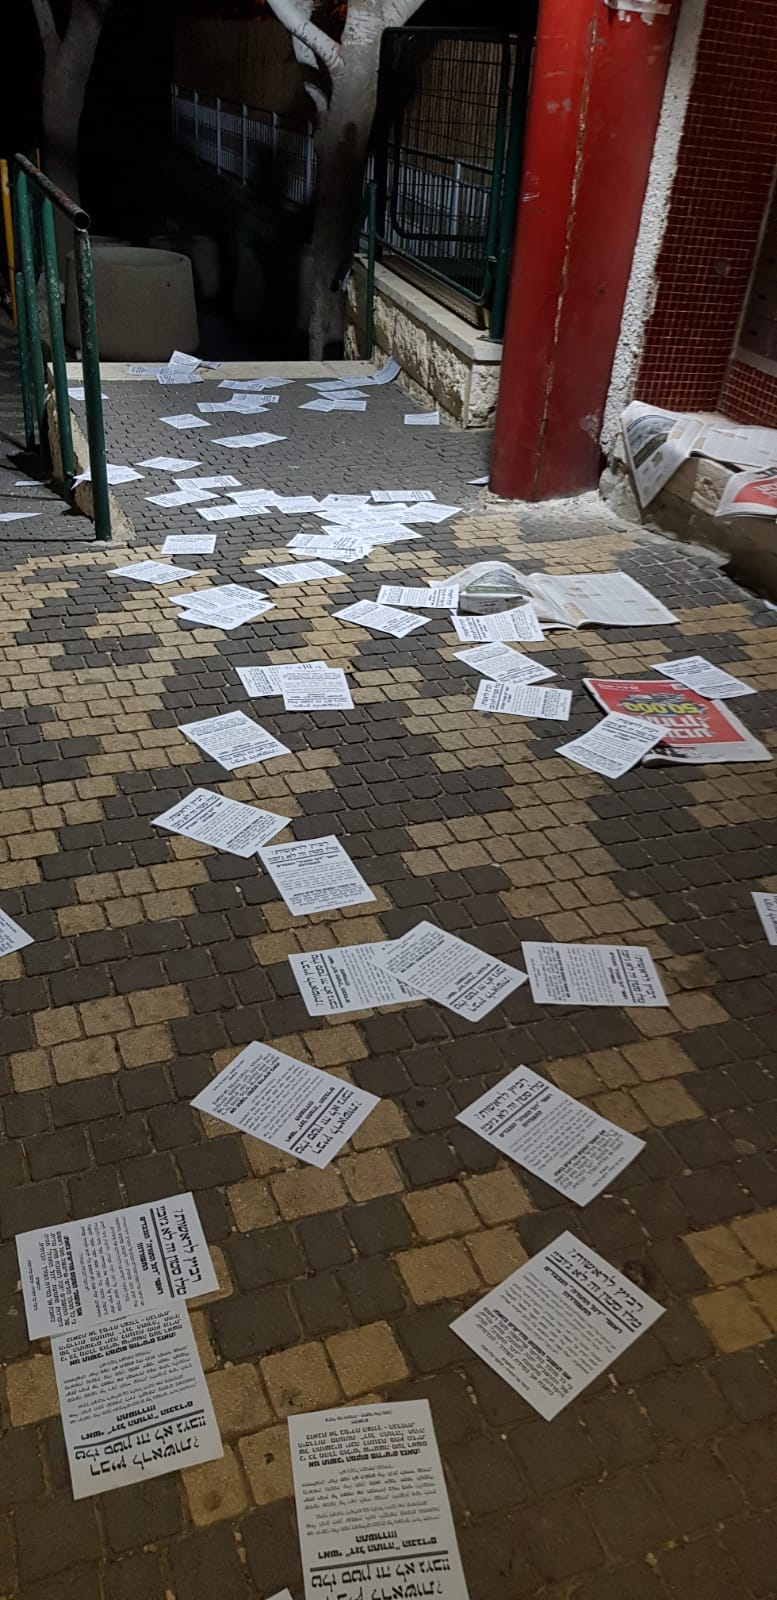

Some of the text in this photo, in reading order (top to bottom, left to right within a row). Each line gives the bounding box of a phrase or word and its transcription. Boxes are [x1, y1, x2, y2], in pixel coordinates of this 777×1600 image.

[527, 1080, 544, 1092] טלז
[473, 1078, 528, 1118] רביץ לראשות?
[506, 1102, 517, 1110] זה
[514, 1090, 532, 1105] סטון
[285, 1130, 297, 1142] ראשי
[318, 1086, 335, 1103] הנכבדים
[495, 1108, 508, 1119] לא
[294, 1140, 312, 1154] טלז
[306, 1123, 323, 1140] סטון
[321, 1116, 331, 1124] זה
[328, 1104, 341, 1116] לא
[312, 1102, 362, 1153] רביץ לראשות?
[139, 1216, 150, 1238] הנכבדים
[161, 1227, 176, 1240] לא
[165, 1242, 175, 1252] זה
[174, 1208, 201, 1282] רביץ לראשות?
[165, 1254, 181, 1275] סטון
[571, 1268, 588, 1281] לא
[154, 1277, 163, 1294] ראשי
[174, 1277, 189, 1295] טלז
[570, 1248, 643, 1311] רביץ לראשות?
[587, 1281, 600, 1292] זה
[597, 1291, 622, 1311] סטון
[622, 1309, 642, 1328] טלז
[81, 1430, 104, 1440] ראשי
[160, 1400, 193, 1415] הנכבדים
[75, 1444, 99, 1461] טלז
[102, 1435, 132, 1454] סטון
[136, 1433, 150, 1445] זה
[154, 1425, 173, 1443] לא
[90, 1436, 199, 1476] רביץ לראשות?
[318, 1549, 342, 1559] ראשי
[401, 1536, 437, 1547] הנכבדים
[311, 1573, 336, 1592] טלז
[341, 1565, 371, 1583] סטון
[376, 1566, 391, 1578] זה
[395, 1562, 415, 1582] לא
